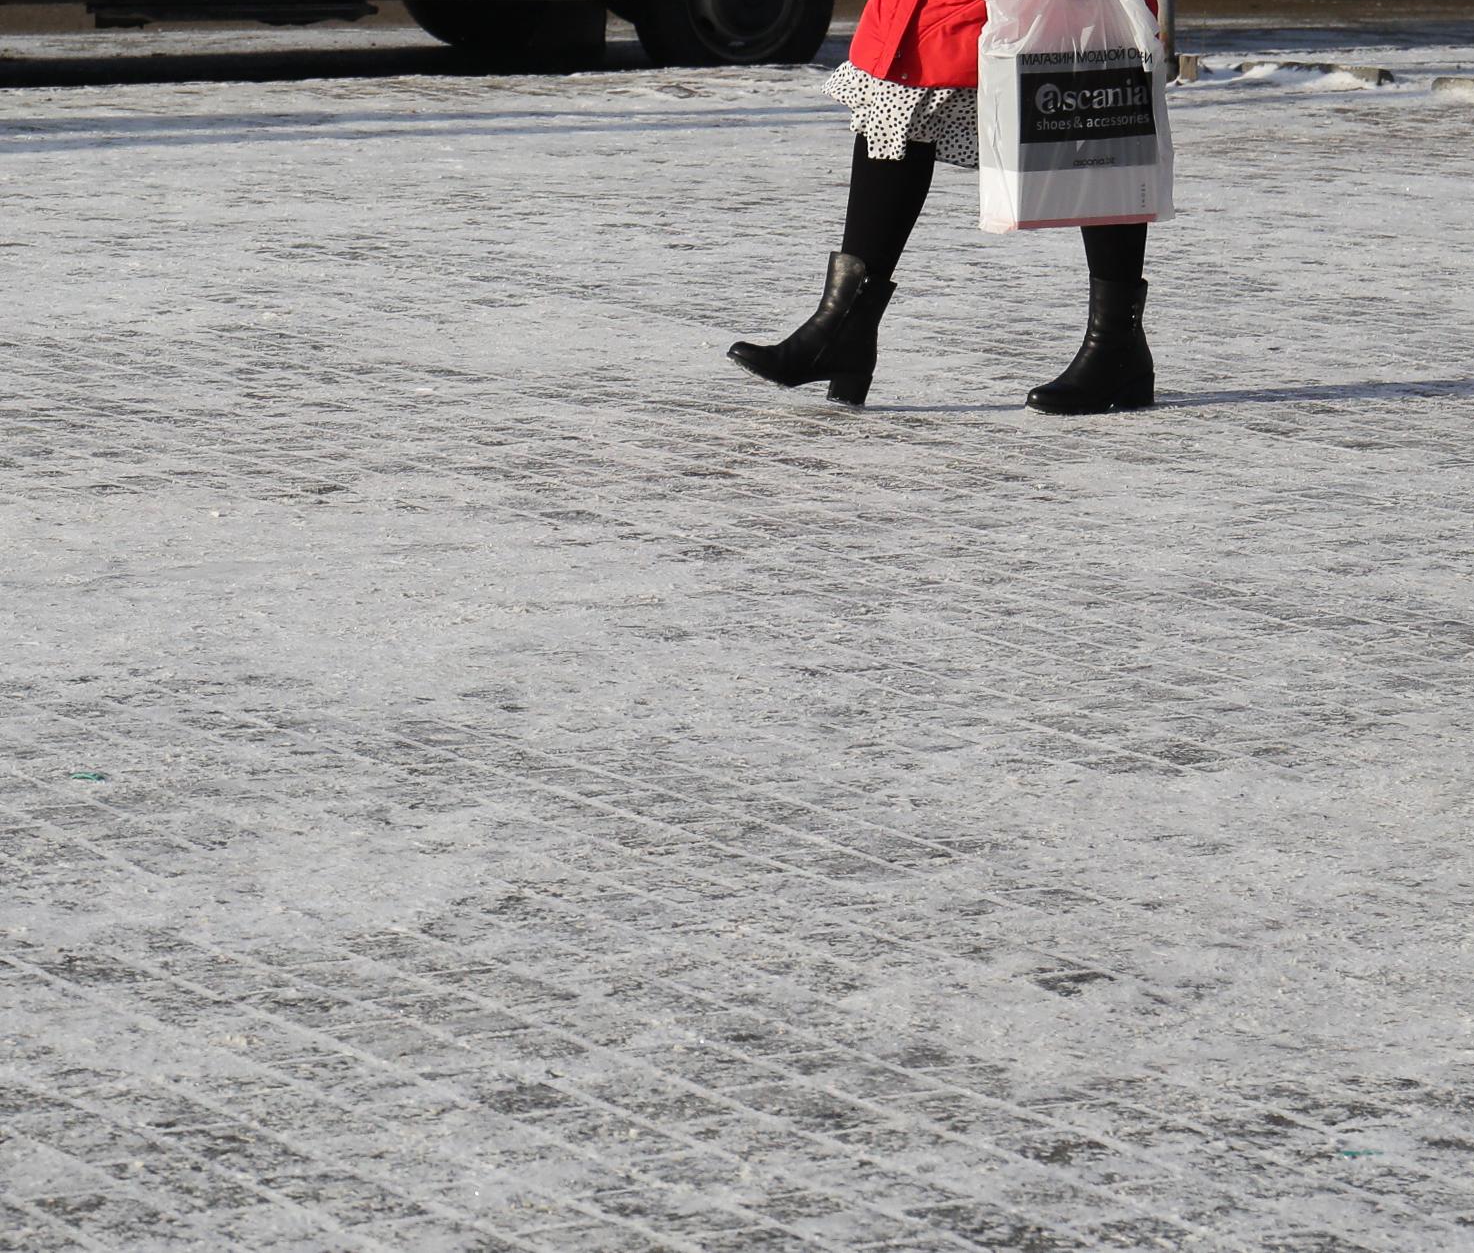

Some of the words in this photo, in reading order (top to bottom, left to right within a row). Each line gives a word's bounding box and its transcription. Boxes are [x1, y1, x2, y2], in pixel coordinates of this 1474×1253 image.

[1021, 52, 1074, 66] МАГАЗИН
[1036, 116, 1071, 131] shoes
[1086, 114, 1150, 129] accessories
